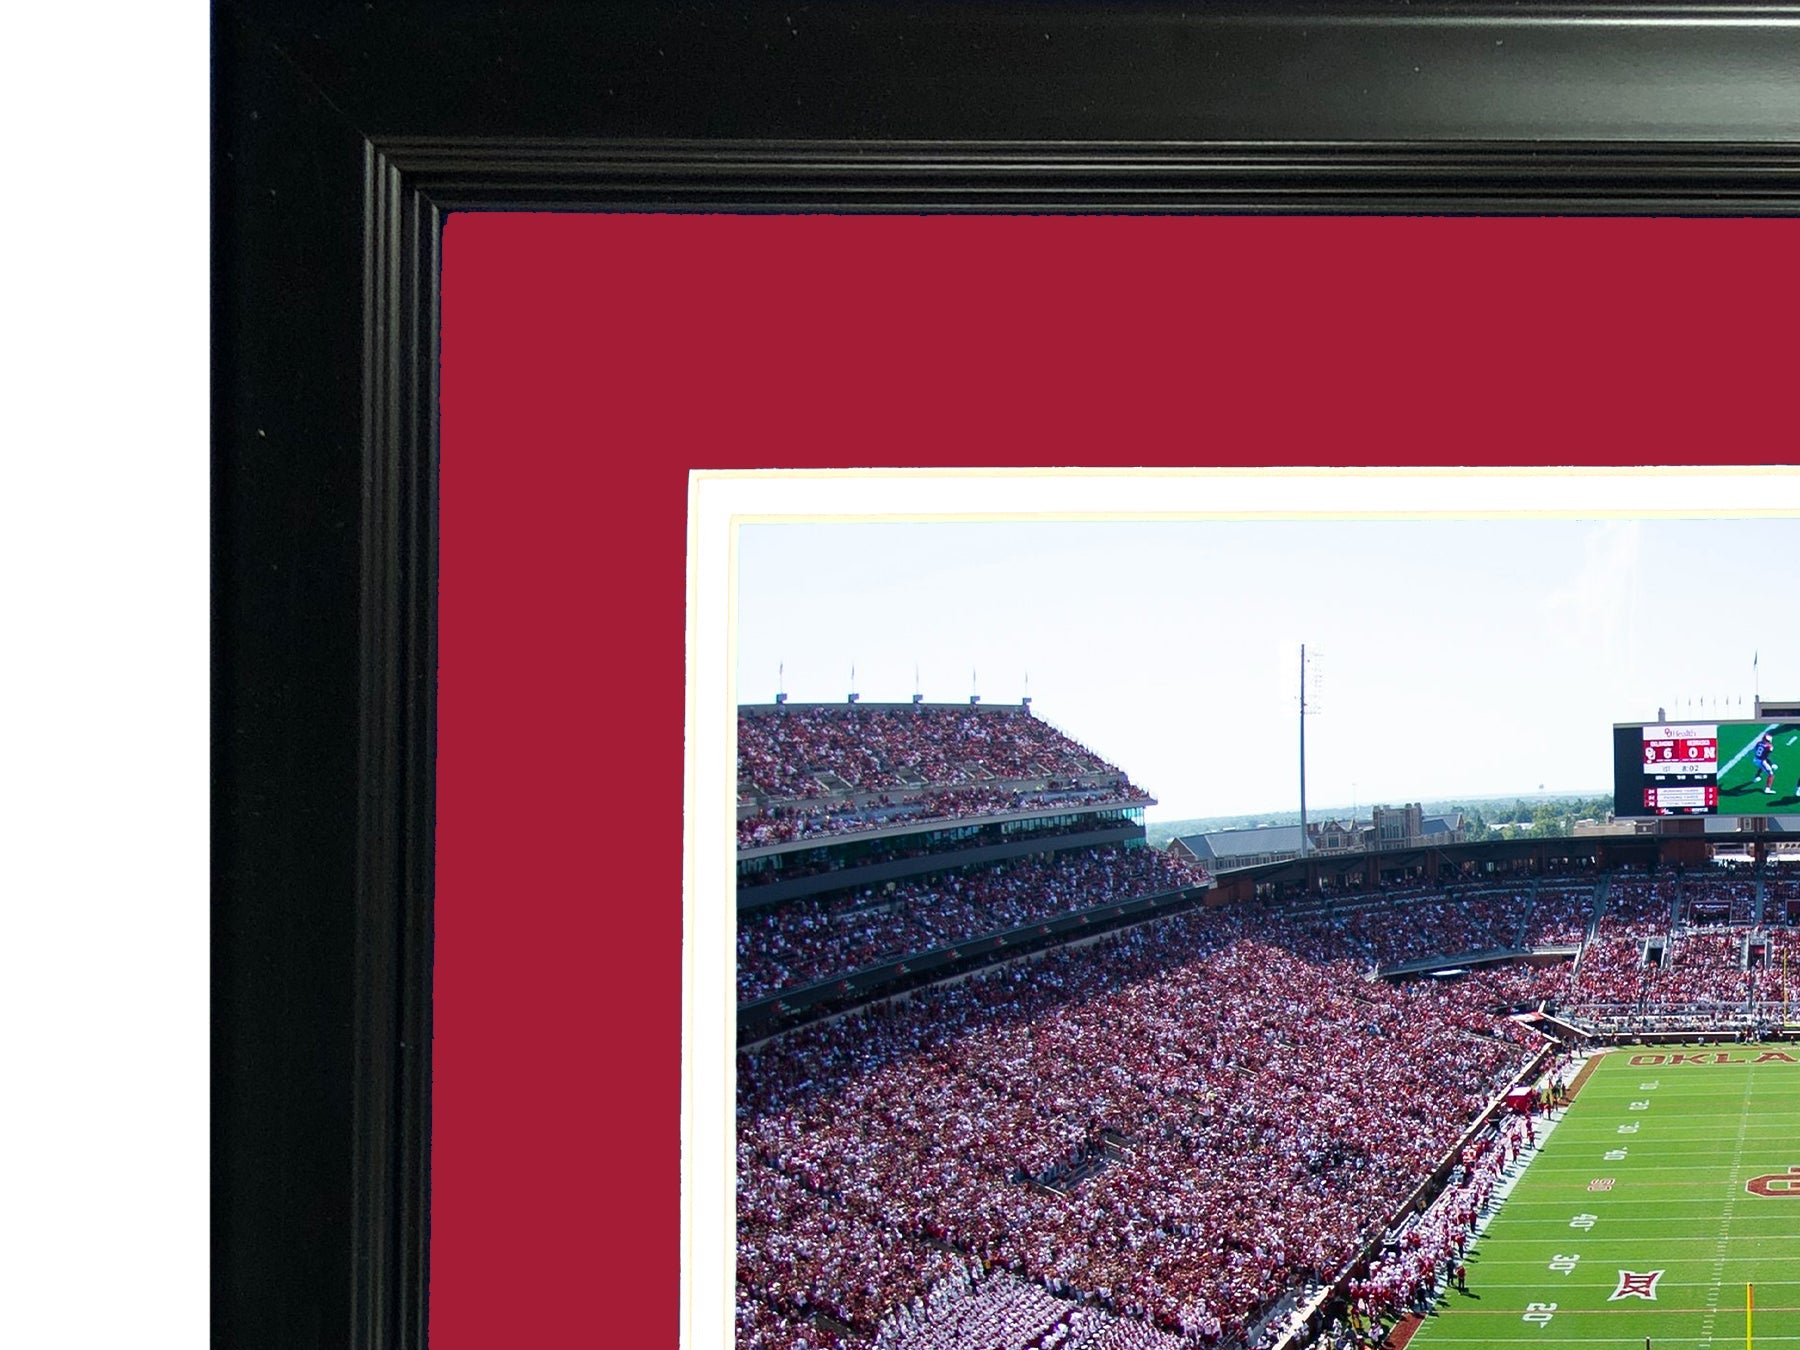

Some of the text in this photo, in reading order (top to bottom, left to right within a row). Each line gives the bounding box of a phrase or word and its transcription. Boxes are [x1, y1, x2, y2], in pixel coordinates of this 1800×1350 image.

[1663, 748, 1672, 759] 6
[1549, 1254, 1580, 1270] 30
[1522, 1303, 1557, 1321] 20
